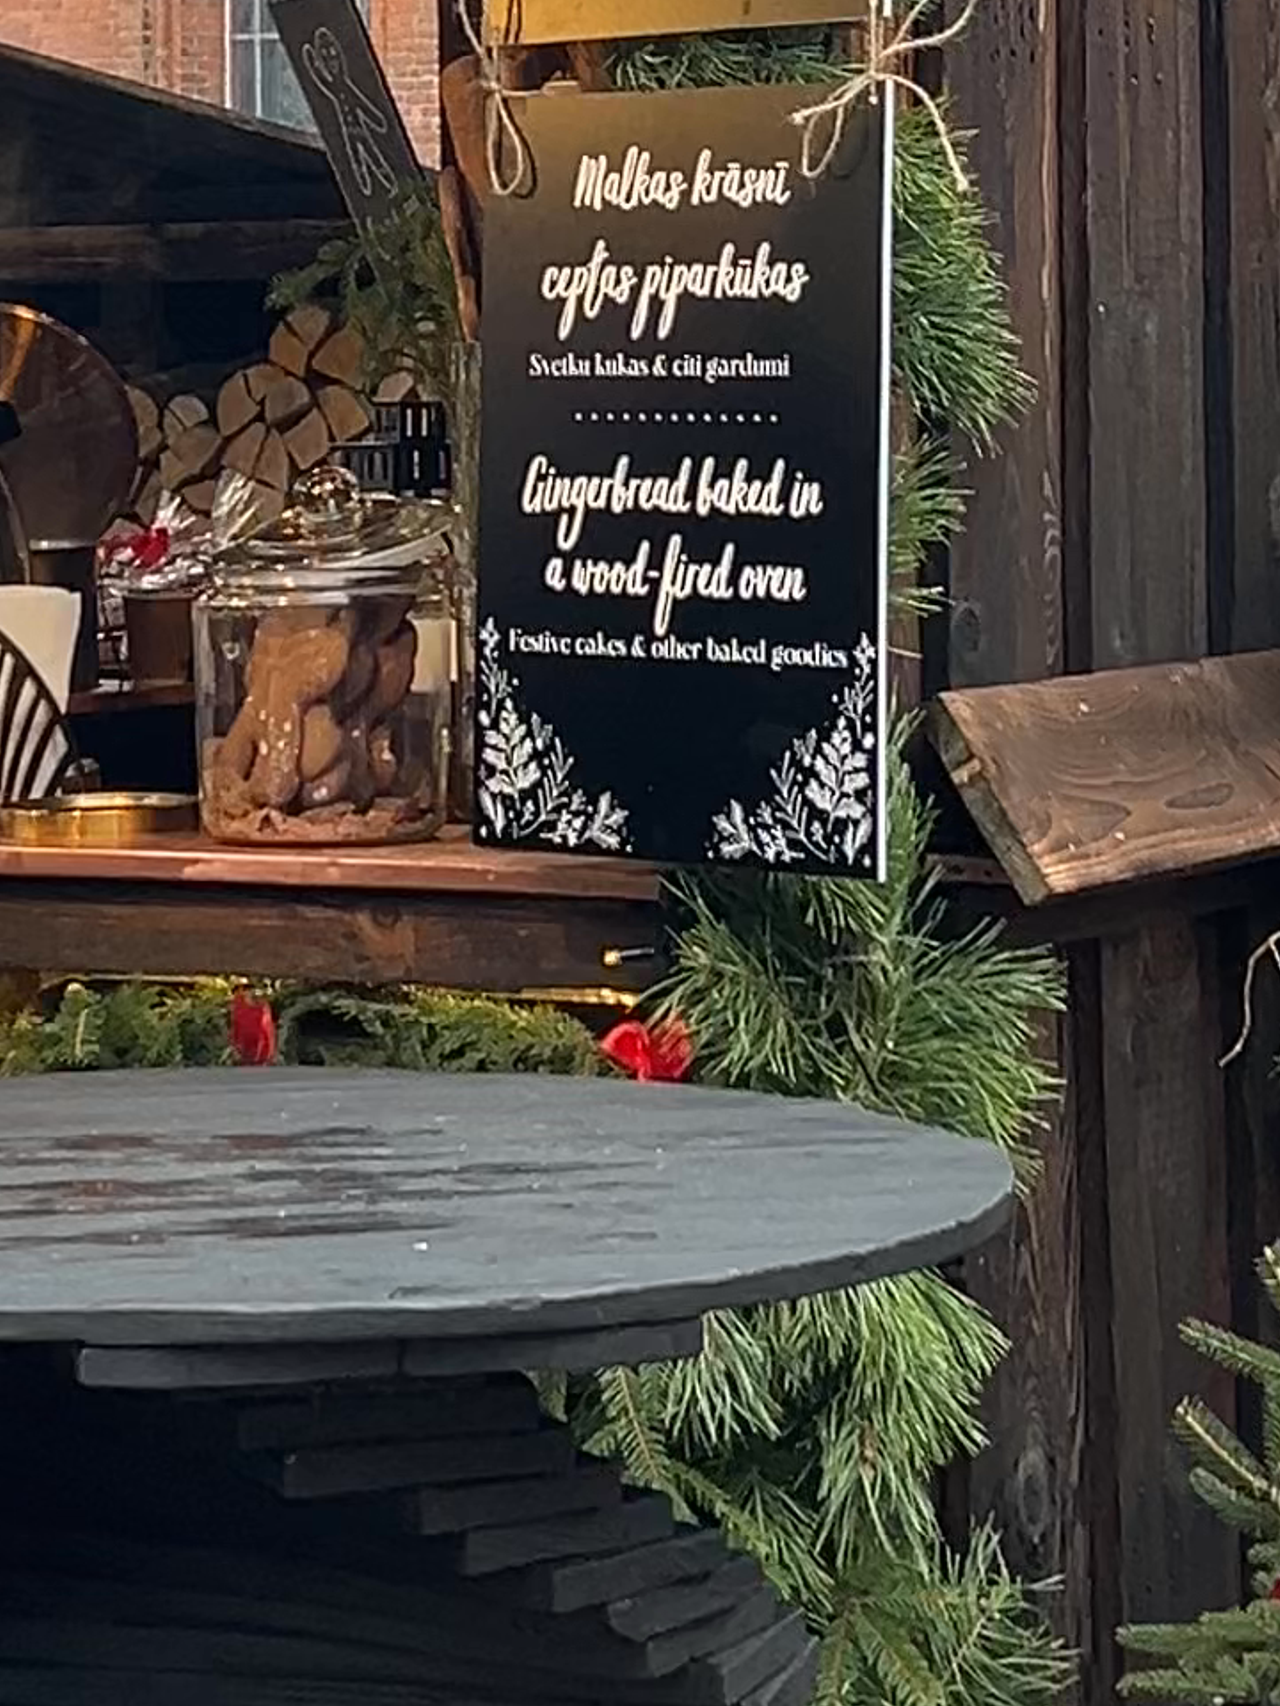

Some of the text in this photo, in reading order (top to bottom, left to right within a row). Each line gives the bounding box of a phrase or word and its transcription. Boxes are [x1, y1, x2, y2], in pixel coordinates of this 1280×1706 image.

[573, 145, 791, 211] Malkas krāsnī
[541, 239, 810, 341] ceptas piparkūkas
[652, 354, 669, 377] &
[705, 352, 790, 384] gardumi
[522, 454, 823, 550] Gingerbread baked in
[544, 533, 806, 637] a wood-fired oven
[509, 628, 849, 671] Festive cakes & other baked goodies
